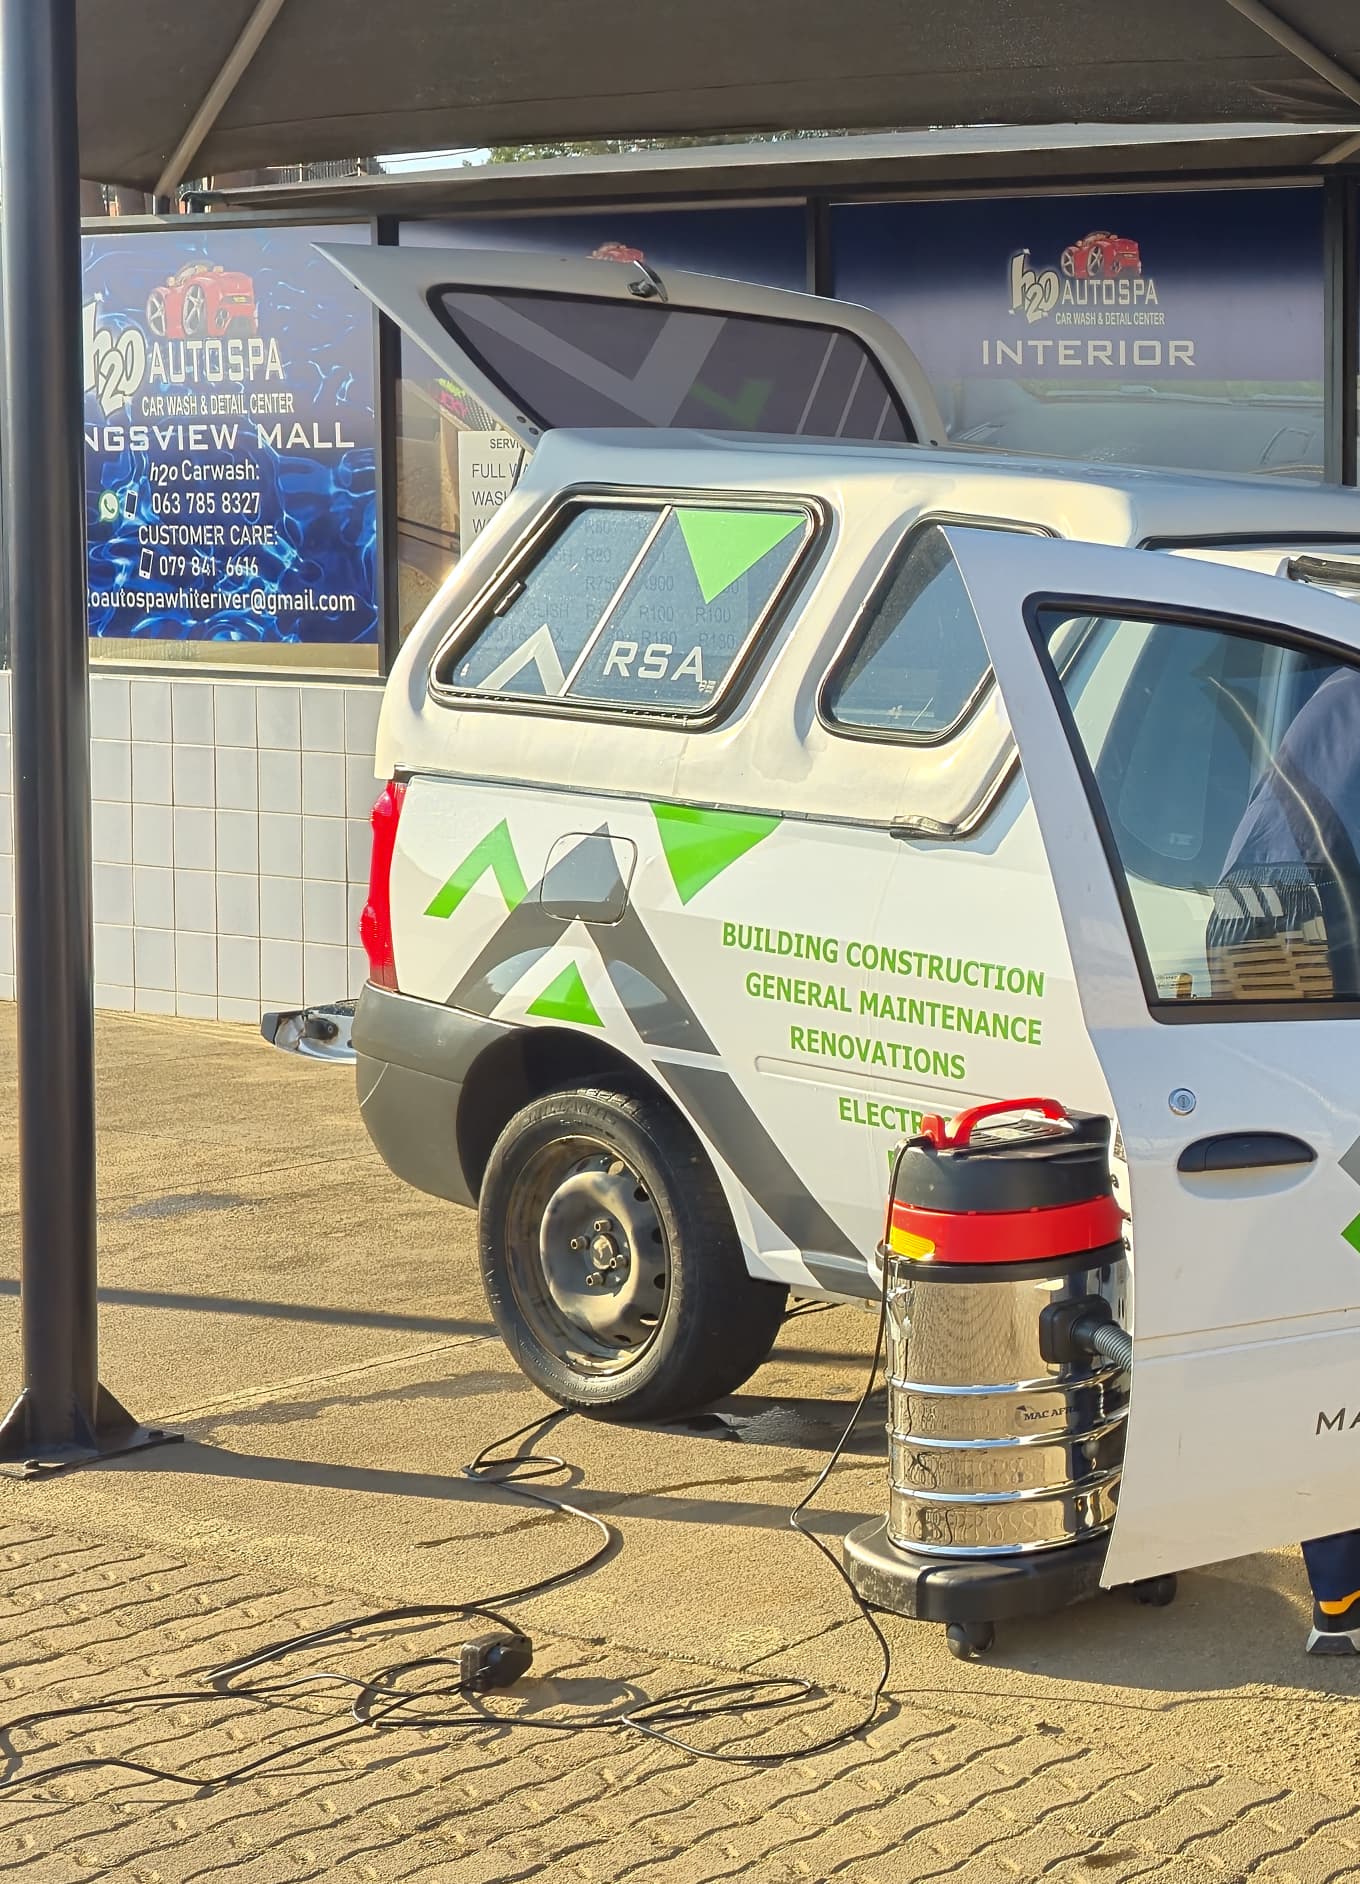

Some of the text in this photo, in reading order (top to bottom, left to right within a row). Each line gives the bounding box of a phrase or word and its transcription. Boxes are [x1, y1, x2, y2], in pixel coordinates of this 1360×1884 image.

[1062, 279, 1158, 305] AUTOSPA
[1055, 312, 1165, 325] CAR WASH & DETAIL CENTER
[149, 337, 286, 384] AUTOSPA
[983, 340, 1196, 365] INTERIOR
[142, 392, 294, 416] CAR WASH & DETAIL CENTER
[257, 421, 354, 449] MALL
[182, 459, 260, 482] Carwash:
[472, 463, 506, 478] FULL
[152, 492, 260, 514] 063 785 8327
[139, 525, 278, 546] CUSTOMER CARE:
[160, 556, 259, 577] 079 841 6616
[603, 641, 703, 683] RSA
[722, 922, 1045, 998] BUILDING CONSTRUCTION
[746, 972, 1042, 1046] GENERAL MAINTENANCE
[790, 1025, 966, 1080] RENOVATIONS
[839, 1096, 952, 1135] ELECTR
